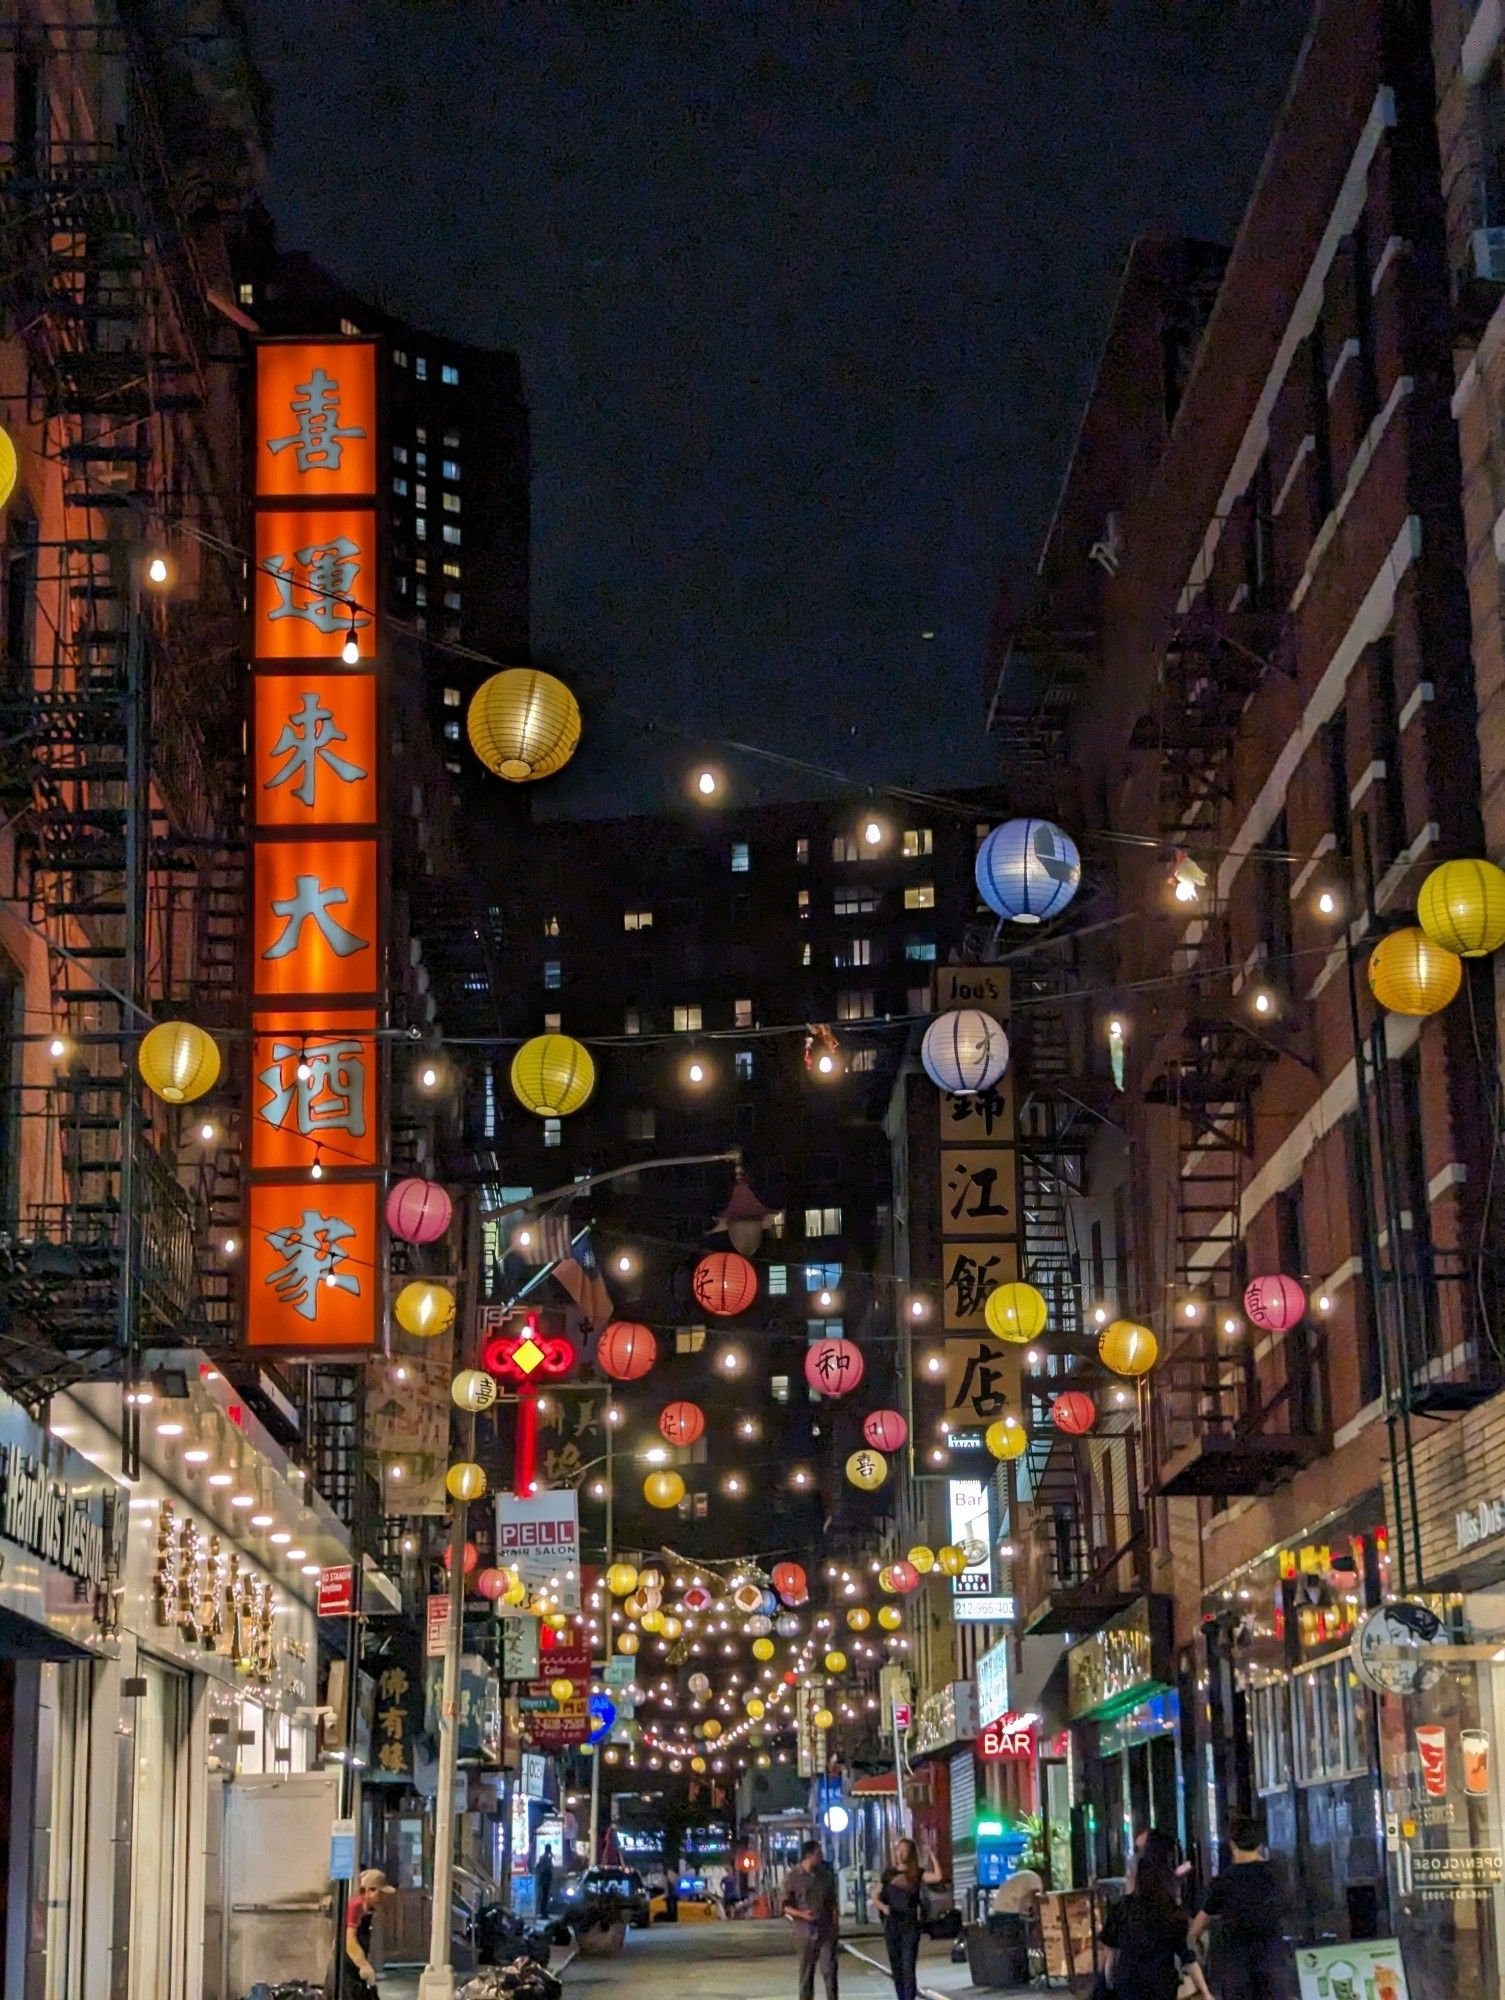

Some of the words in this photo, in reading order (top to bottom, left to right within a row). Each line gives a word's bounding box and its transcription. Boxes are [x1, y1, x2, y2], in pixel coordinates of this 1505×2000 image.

[262, 368, 370, 1321] 喜運來大酒家
[815, 1348, 850, 1379] 和
[856, 1452, 876, 1477] 喜
[955, 1493, 982, 1507] Bar
[502, 1524, 572, 1545] PELL
[501, 1548, 530, 1557] HAIR
[535, 1546, 576, 1556] SALON
[955, 1602, 973, 1614] 212
[984, 1733, 1031, 1755] BAR
